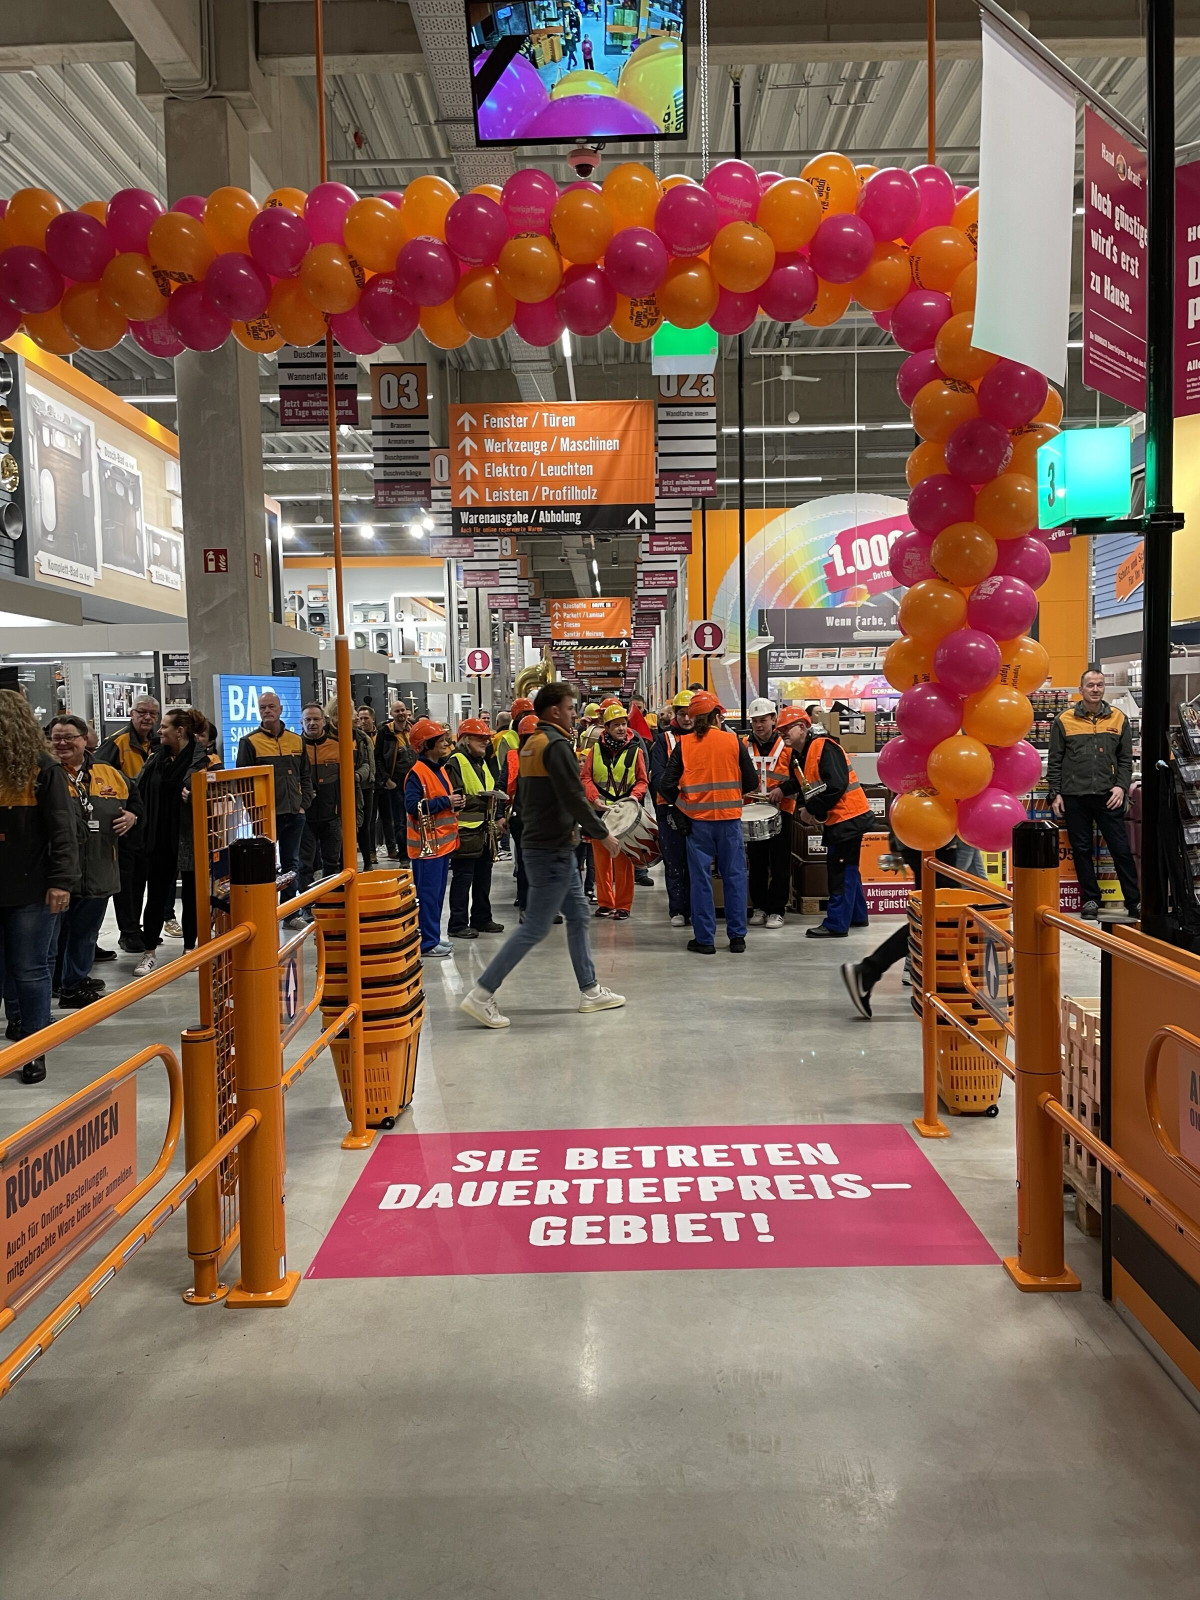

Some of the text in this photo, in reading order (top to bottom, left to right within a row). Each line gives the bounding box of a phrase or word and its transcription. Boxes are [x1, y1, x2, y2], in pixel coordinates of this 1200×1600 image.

[1091, 182, 1148, 249] Noch günstige
[1091, 228, 1139, 279] wird's erst
[1090, 271, 1132, 314] zu Hause.
[294, 350, 341, 359] Duschwanen
[288, 372, 349, 381] Wannenfaltnde
[660, 374, 715, 397] 02a
[379, 372, 419, 410] 03
[295, 409, 309, 418] Tage
[312, 409, 354, 417] weiteparen.
[483, 413, 528, 429] Fenster
[542, 413, 576, 427] Türen
[484, 438, 547, 455] Werkzeuge
[560, 436, 620, 451] Maschinen
[434, 454, 449, 482] 0
[484, 463, 527, 478] Elektro
[540, 462, 593, 477] Leuchten
[485, 487, 529, 502] Leisten
[542, 486, 598, 500] Profilholz
[1048, 462, 1055, 507] 3
[460, 511, 528, 526] Warenausgabe
[539, 510, 582, 525] Abholung
[826, 616, 851, 626] Wenn
[856, 615, 887, 627] Farbe,
[1060, 848, 1074, 860] 95
[1060, 886, 1080, 895] reise.
[879, 898, 910, 911] günsti
[1060, 897, 1080, 910] stig!
[6, 1102, 119, 1219] RÜCKNAHMEN
[452, 1142, 840, 1173] SIE BETRETEN
[6, 1166, 108, 1260] Auch für Online-Bestellungen,
[6, 1165, 133, 1285] mitgebrachte Ware bitte hier anmelden.
[528, 1212, 775, 1247] GEBIET!
